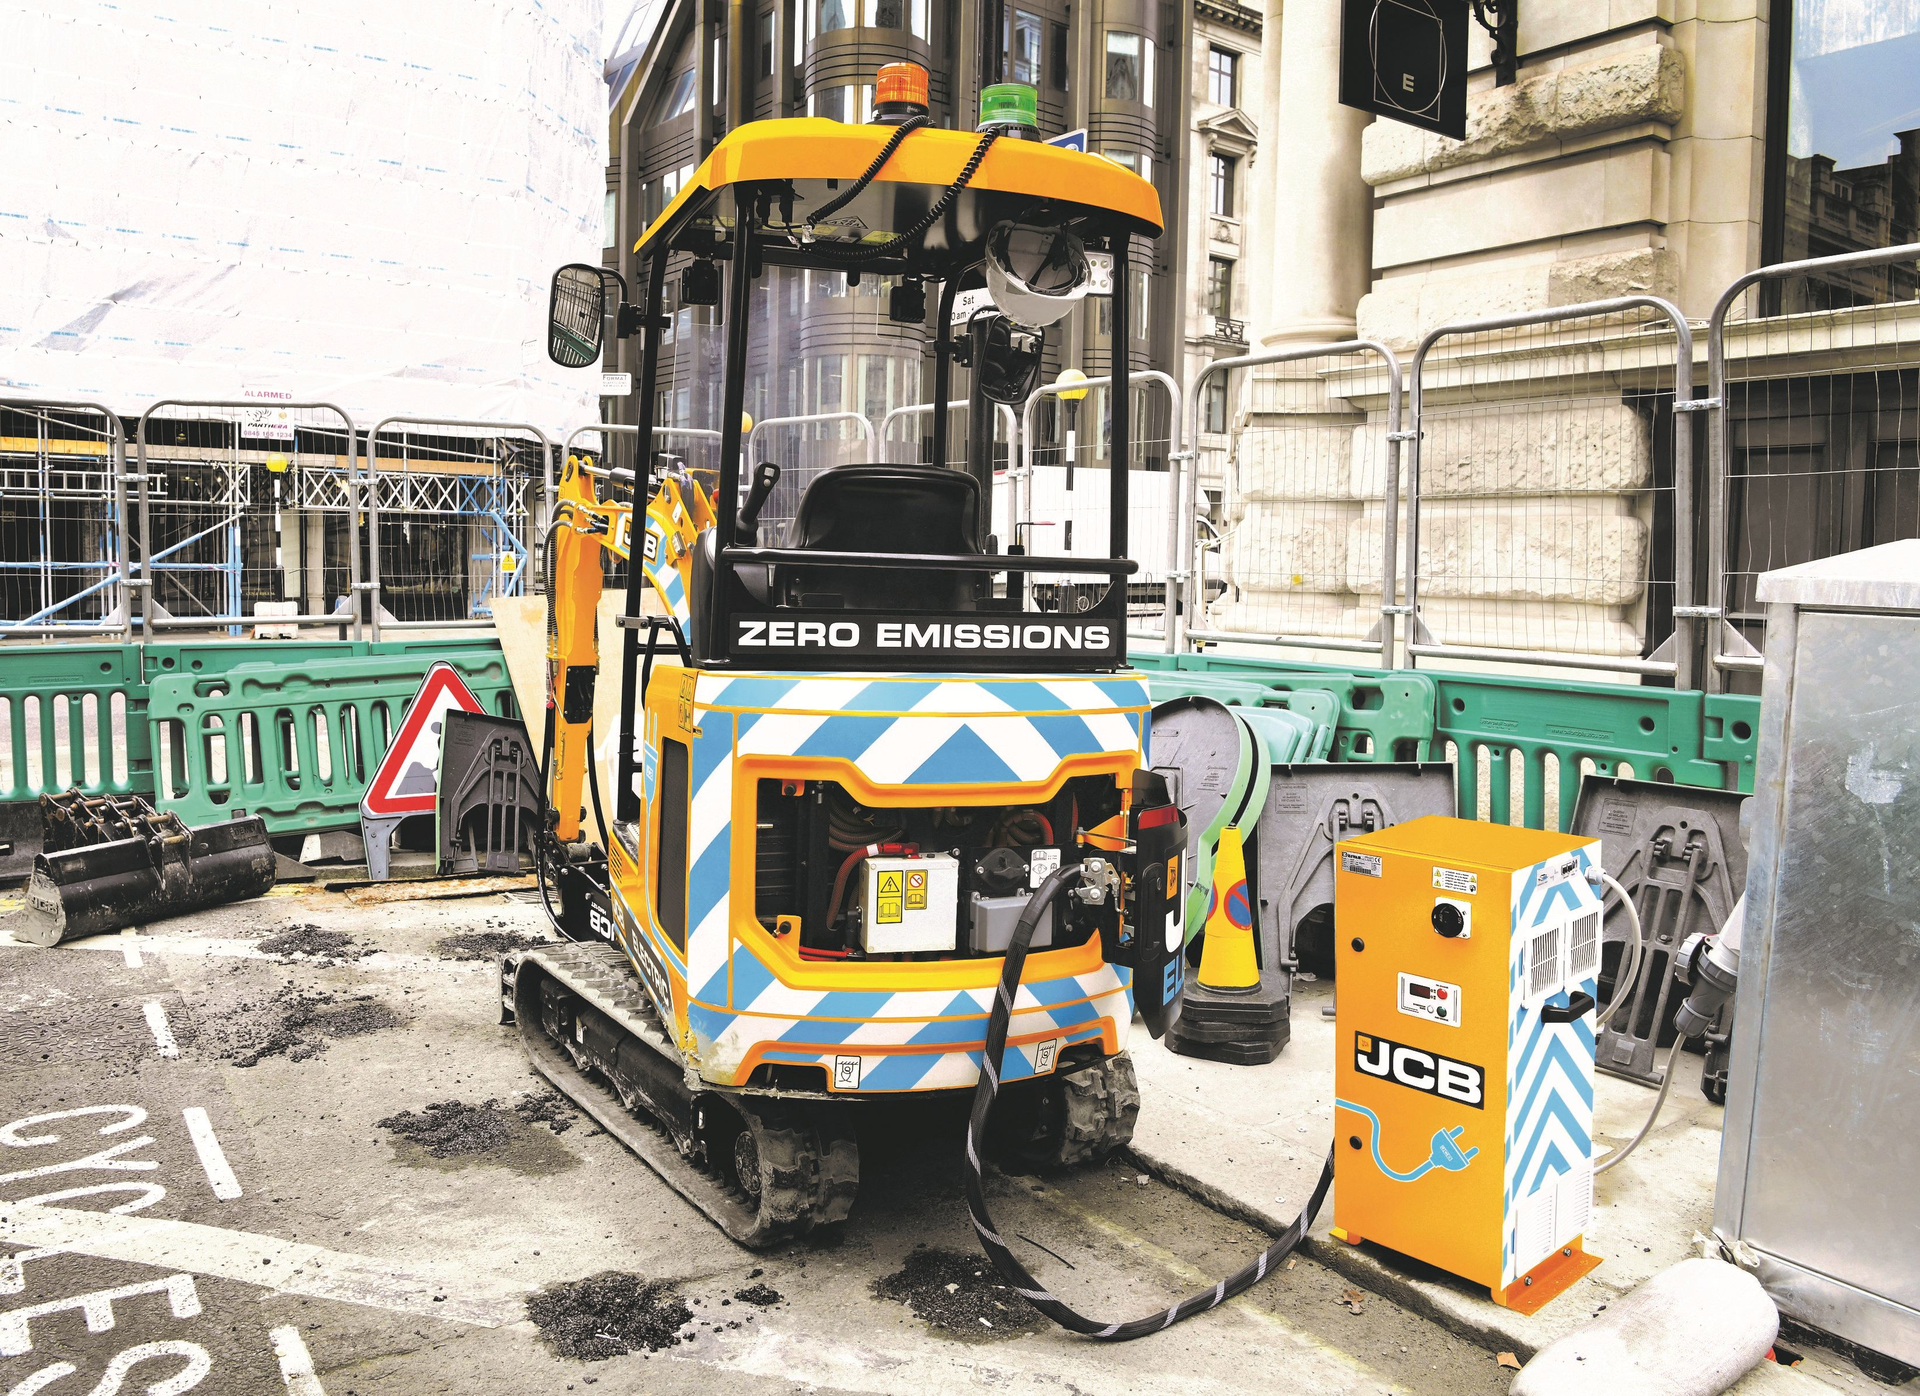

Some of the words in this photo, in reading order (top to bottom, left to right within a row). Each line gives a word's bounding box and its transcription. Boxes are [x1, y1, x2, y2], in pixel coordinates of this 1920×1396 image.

[1402, 73, 1414, 92] E
[962, 295, 974, 305] Sat
[244, 391, 292, 399] ALARMED
[738, 621, 860, 647] ZERO
[876, 623, 1110, 650] EMISSIONS
[631, 929, 669, 1006] ELECTRIC
[1357, 1041, 1482, 1104] JCB
